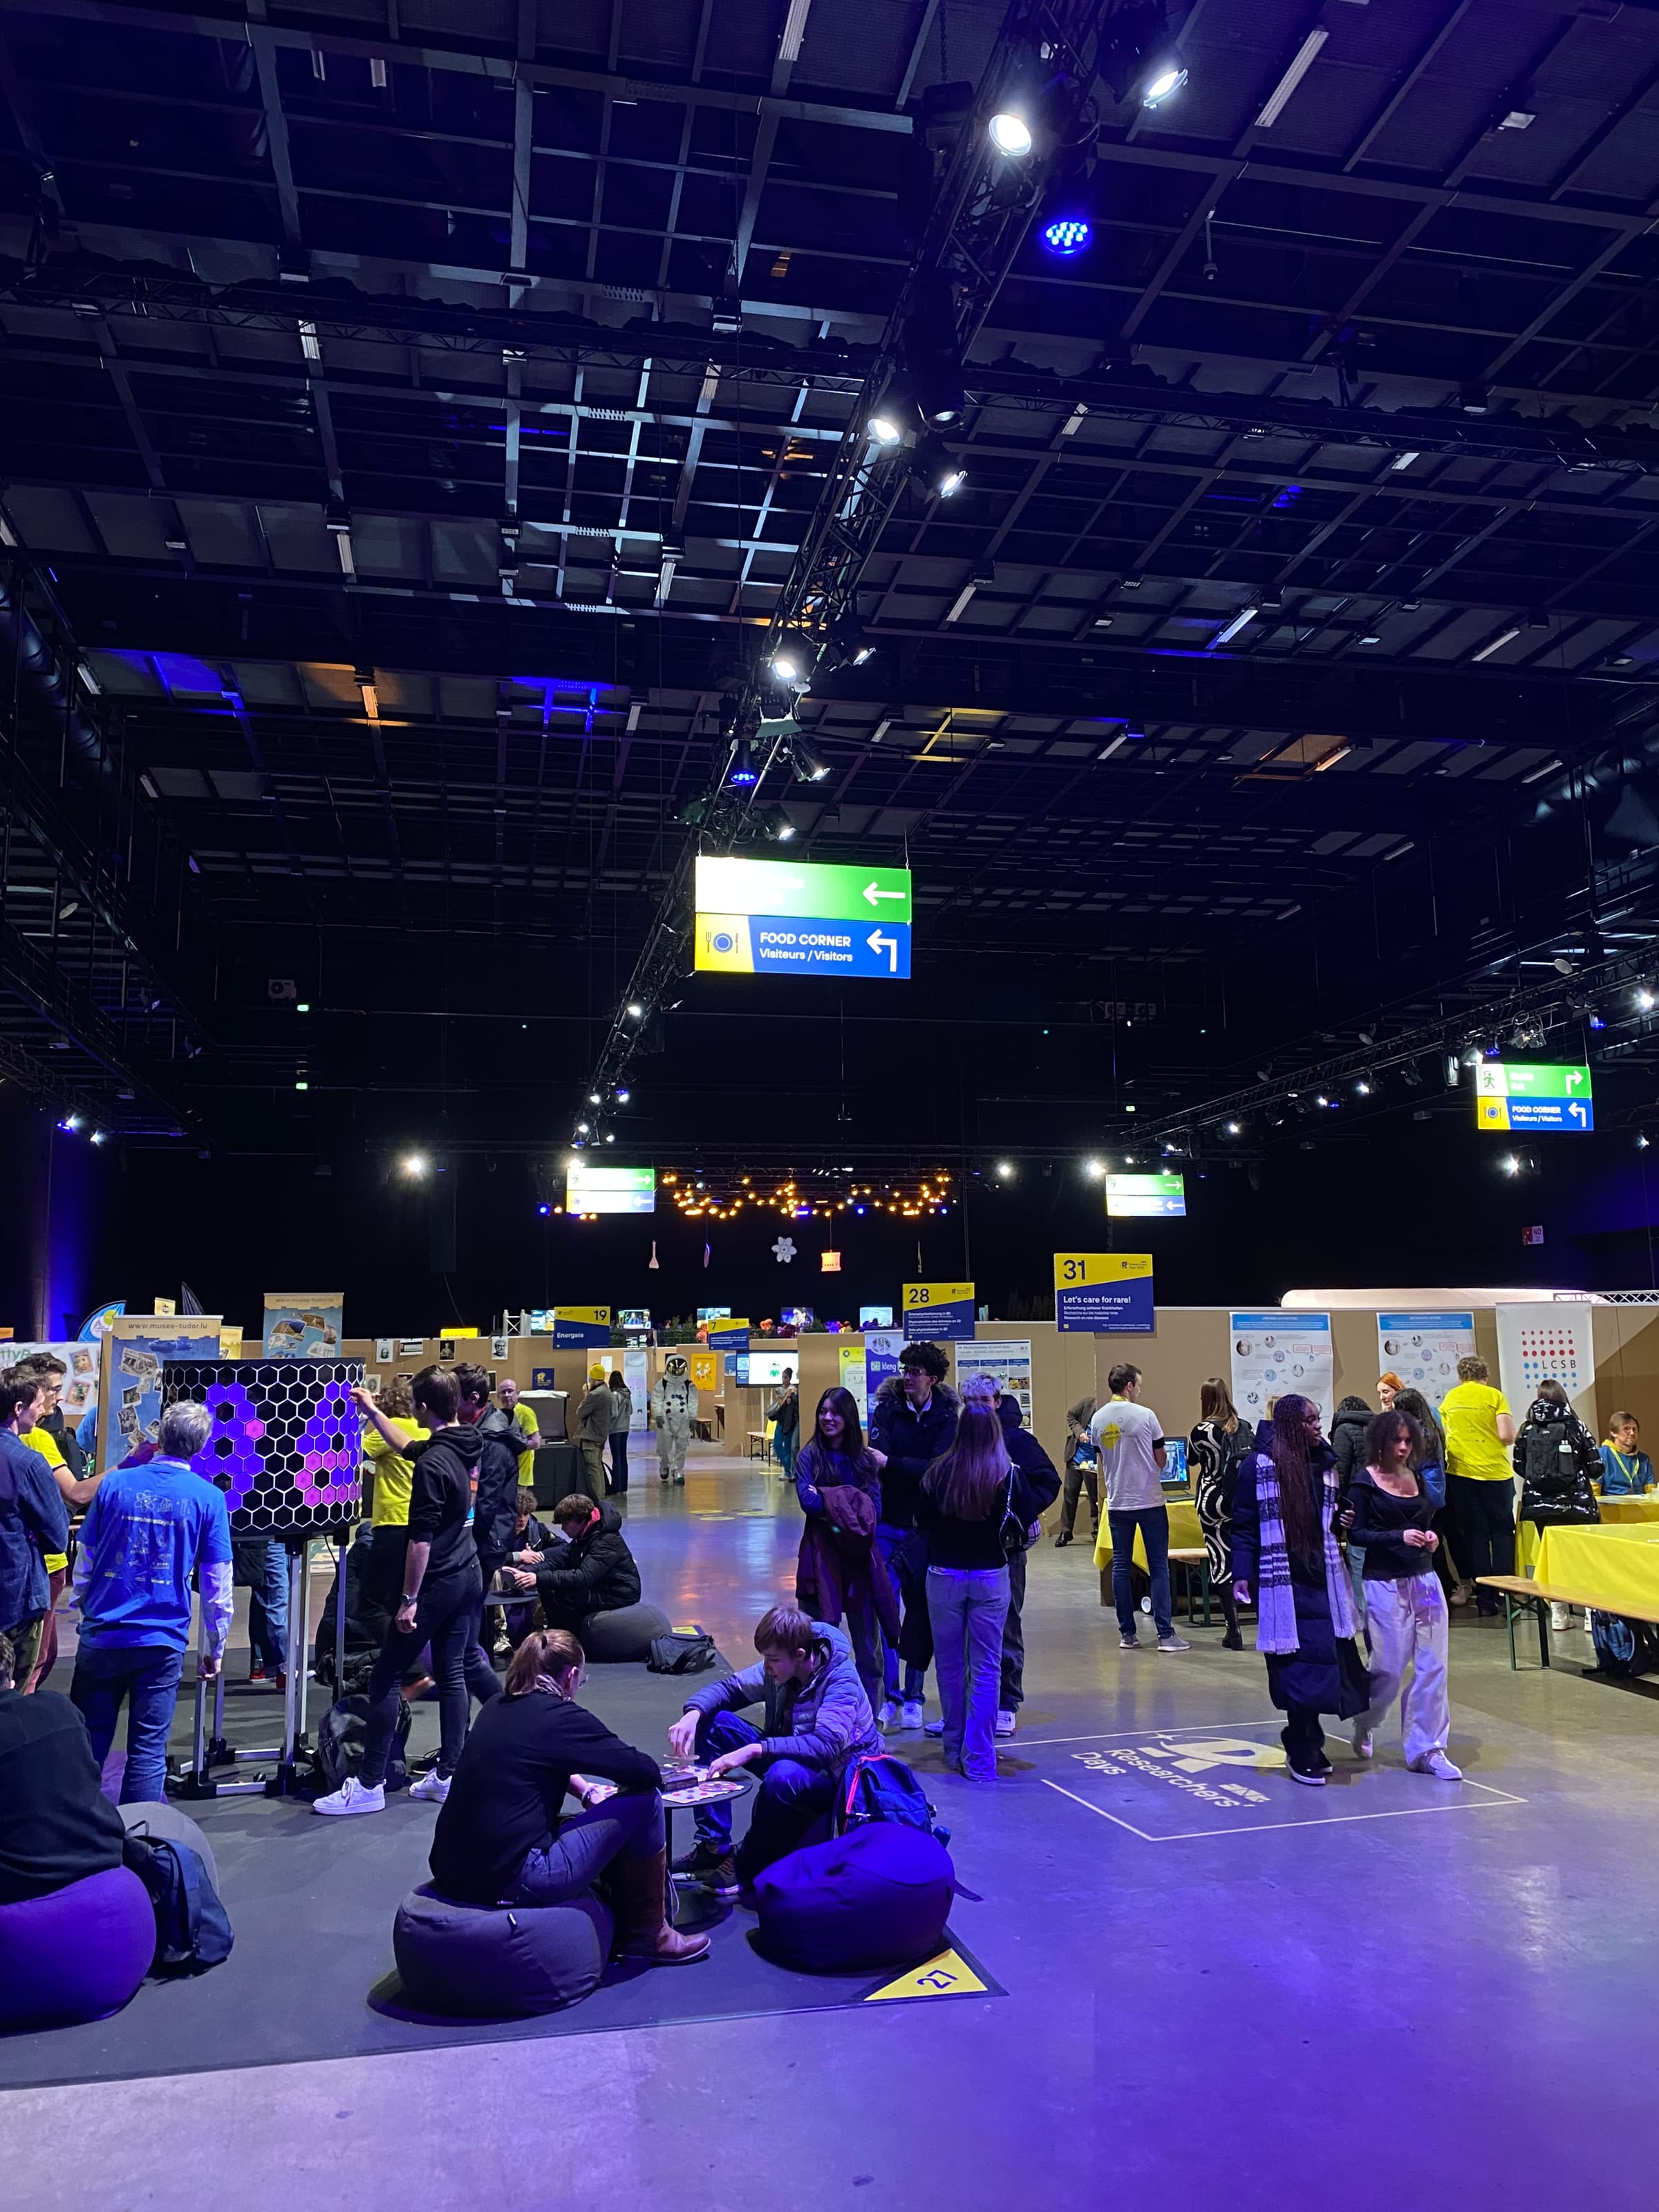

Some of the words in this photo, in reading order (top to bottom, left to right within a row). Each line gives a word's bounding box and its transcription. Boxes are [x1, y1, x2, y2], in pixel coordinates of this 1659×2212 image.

[760, 932, 796, 945] FOOD
[798, 933, 851, 947] CORNER
[759, 948, 805, 960] Visiteurs
[812, 950, 853, 962] Visitors
[1533, 1106, 1562, 1114] CORNER
[1063, 1259, 1086, 1280] 31
[908, 1288, 930, 1304] 28
[1063, 1295, 1081, 1304] Let's
[1101, 1295, 1113, 1304] for
[593, 1310, 607, 1321] 19
[711, 1321, 717, 1330] 7
[1541, 1360, 1576, 1369] LCSB
[1070, 1752, 1127, 1776] Days
[1103, 1748, 1257, 1808] Researchers'
[917, 1969, 959, 1989] 27
